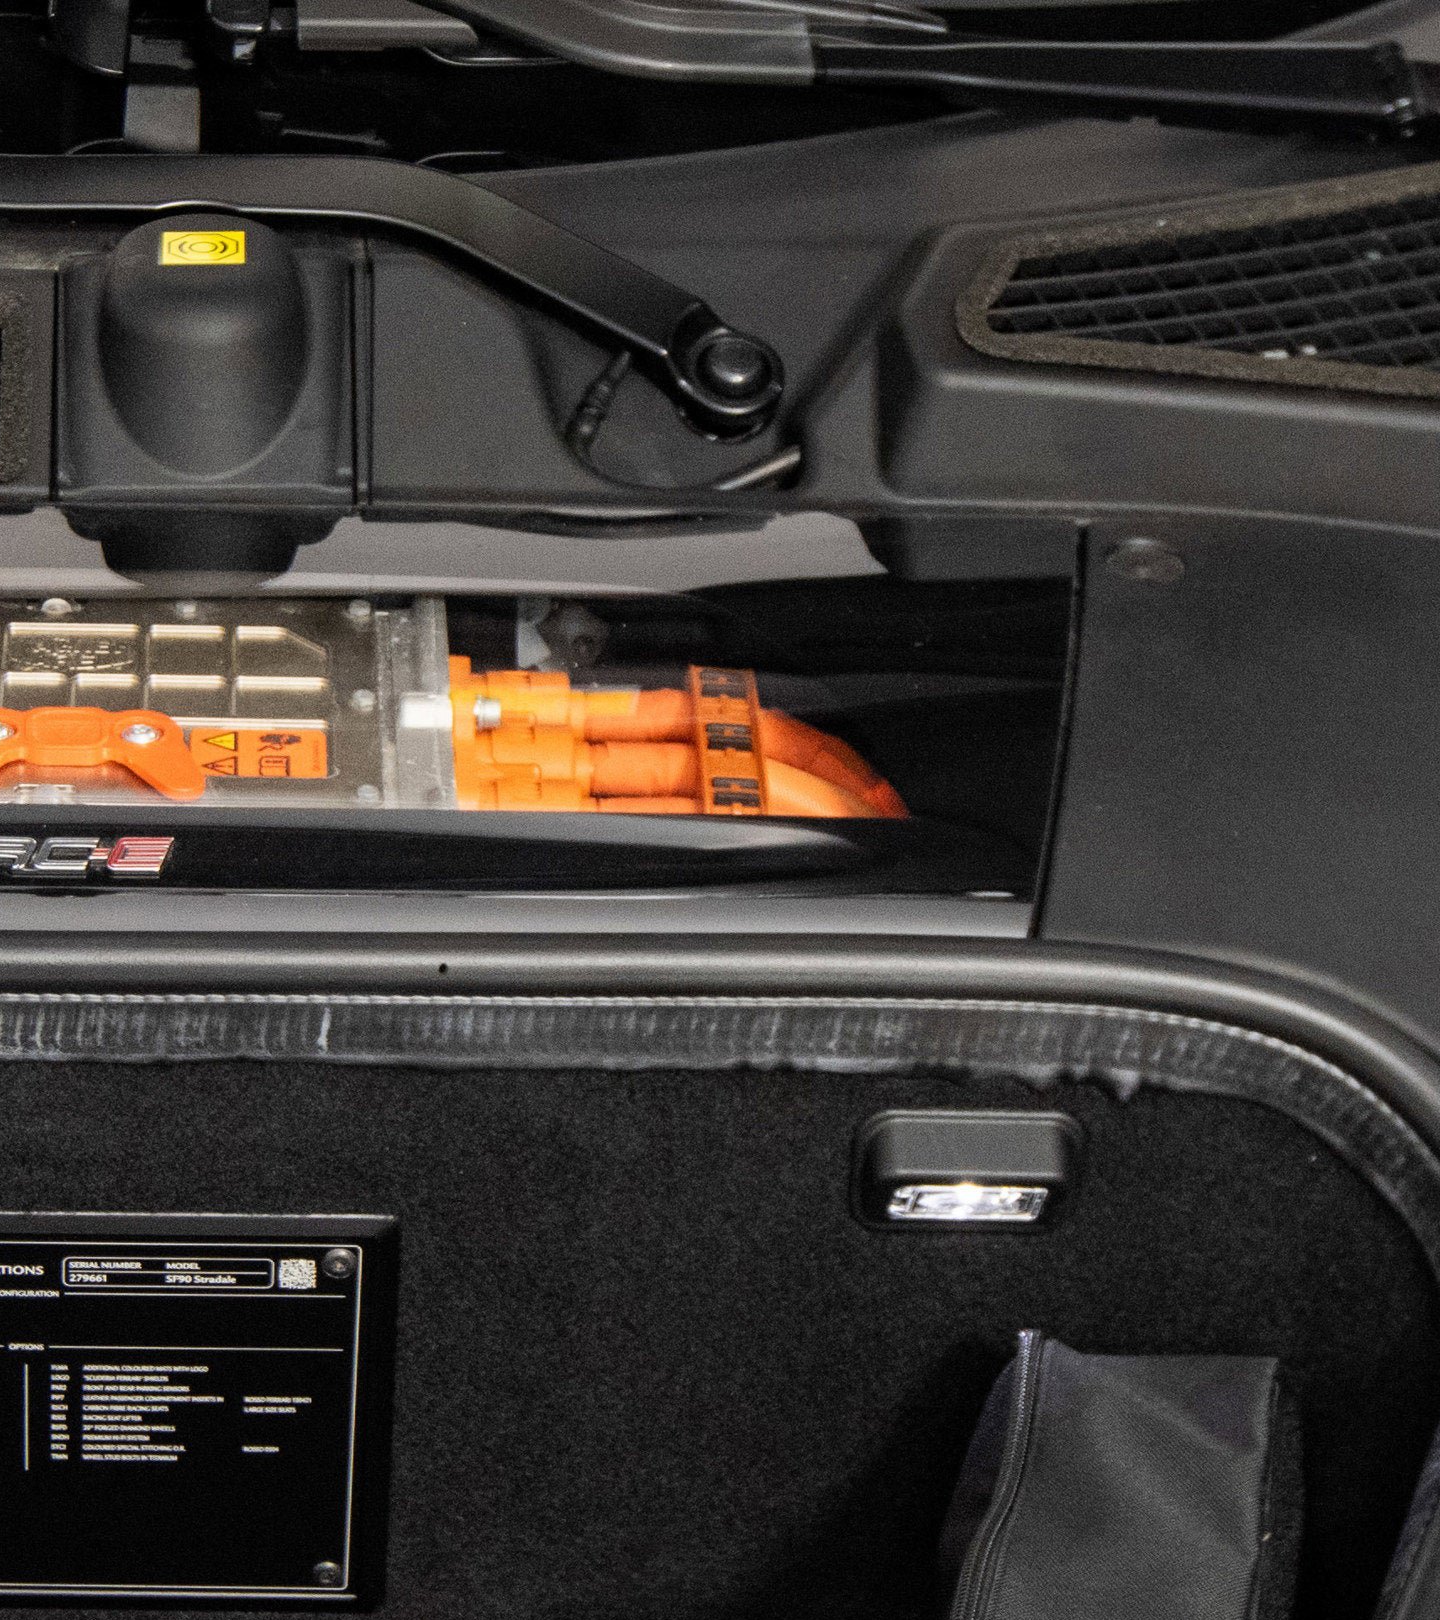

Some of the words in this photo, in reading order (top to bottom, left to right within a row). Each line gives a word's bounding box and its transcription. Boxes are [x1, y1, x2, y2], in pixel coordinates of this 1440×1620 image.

[68, 1261, 99, 1269] SERIAL
[101, 1261, 142, 1270] NUMBER
[165, 1262, 201, 1270] MODEL
[68, 1274, 107, 1283] 279661
[165, 1274, 192, 1283] SF90
[193, 1275, 237, 1284] Stradale
[7, 1343, 45, 1351] OPTIONS
